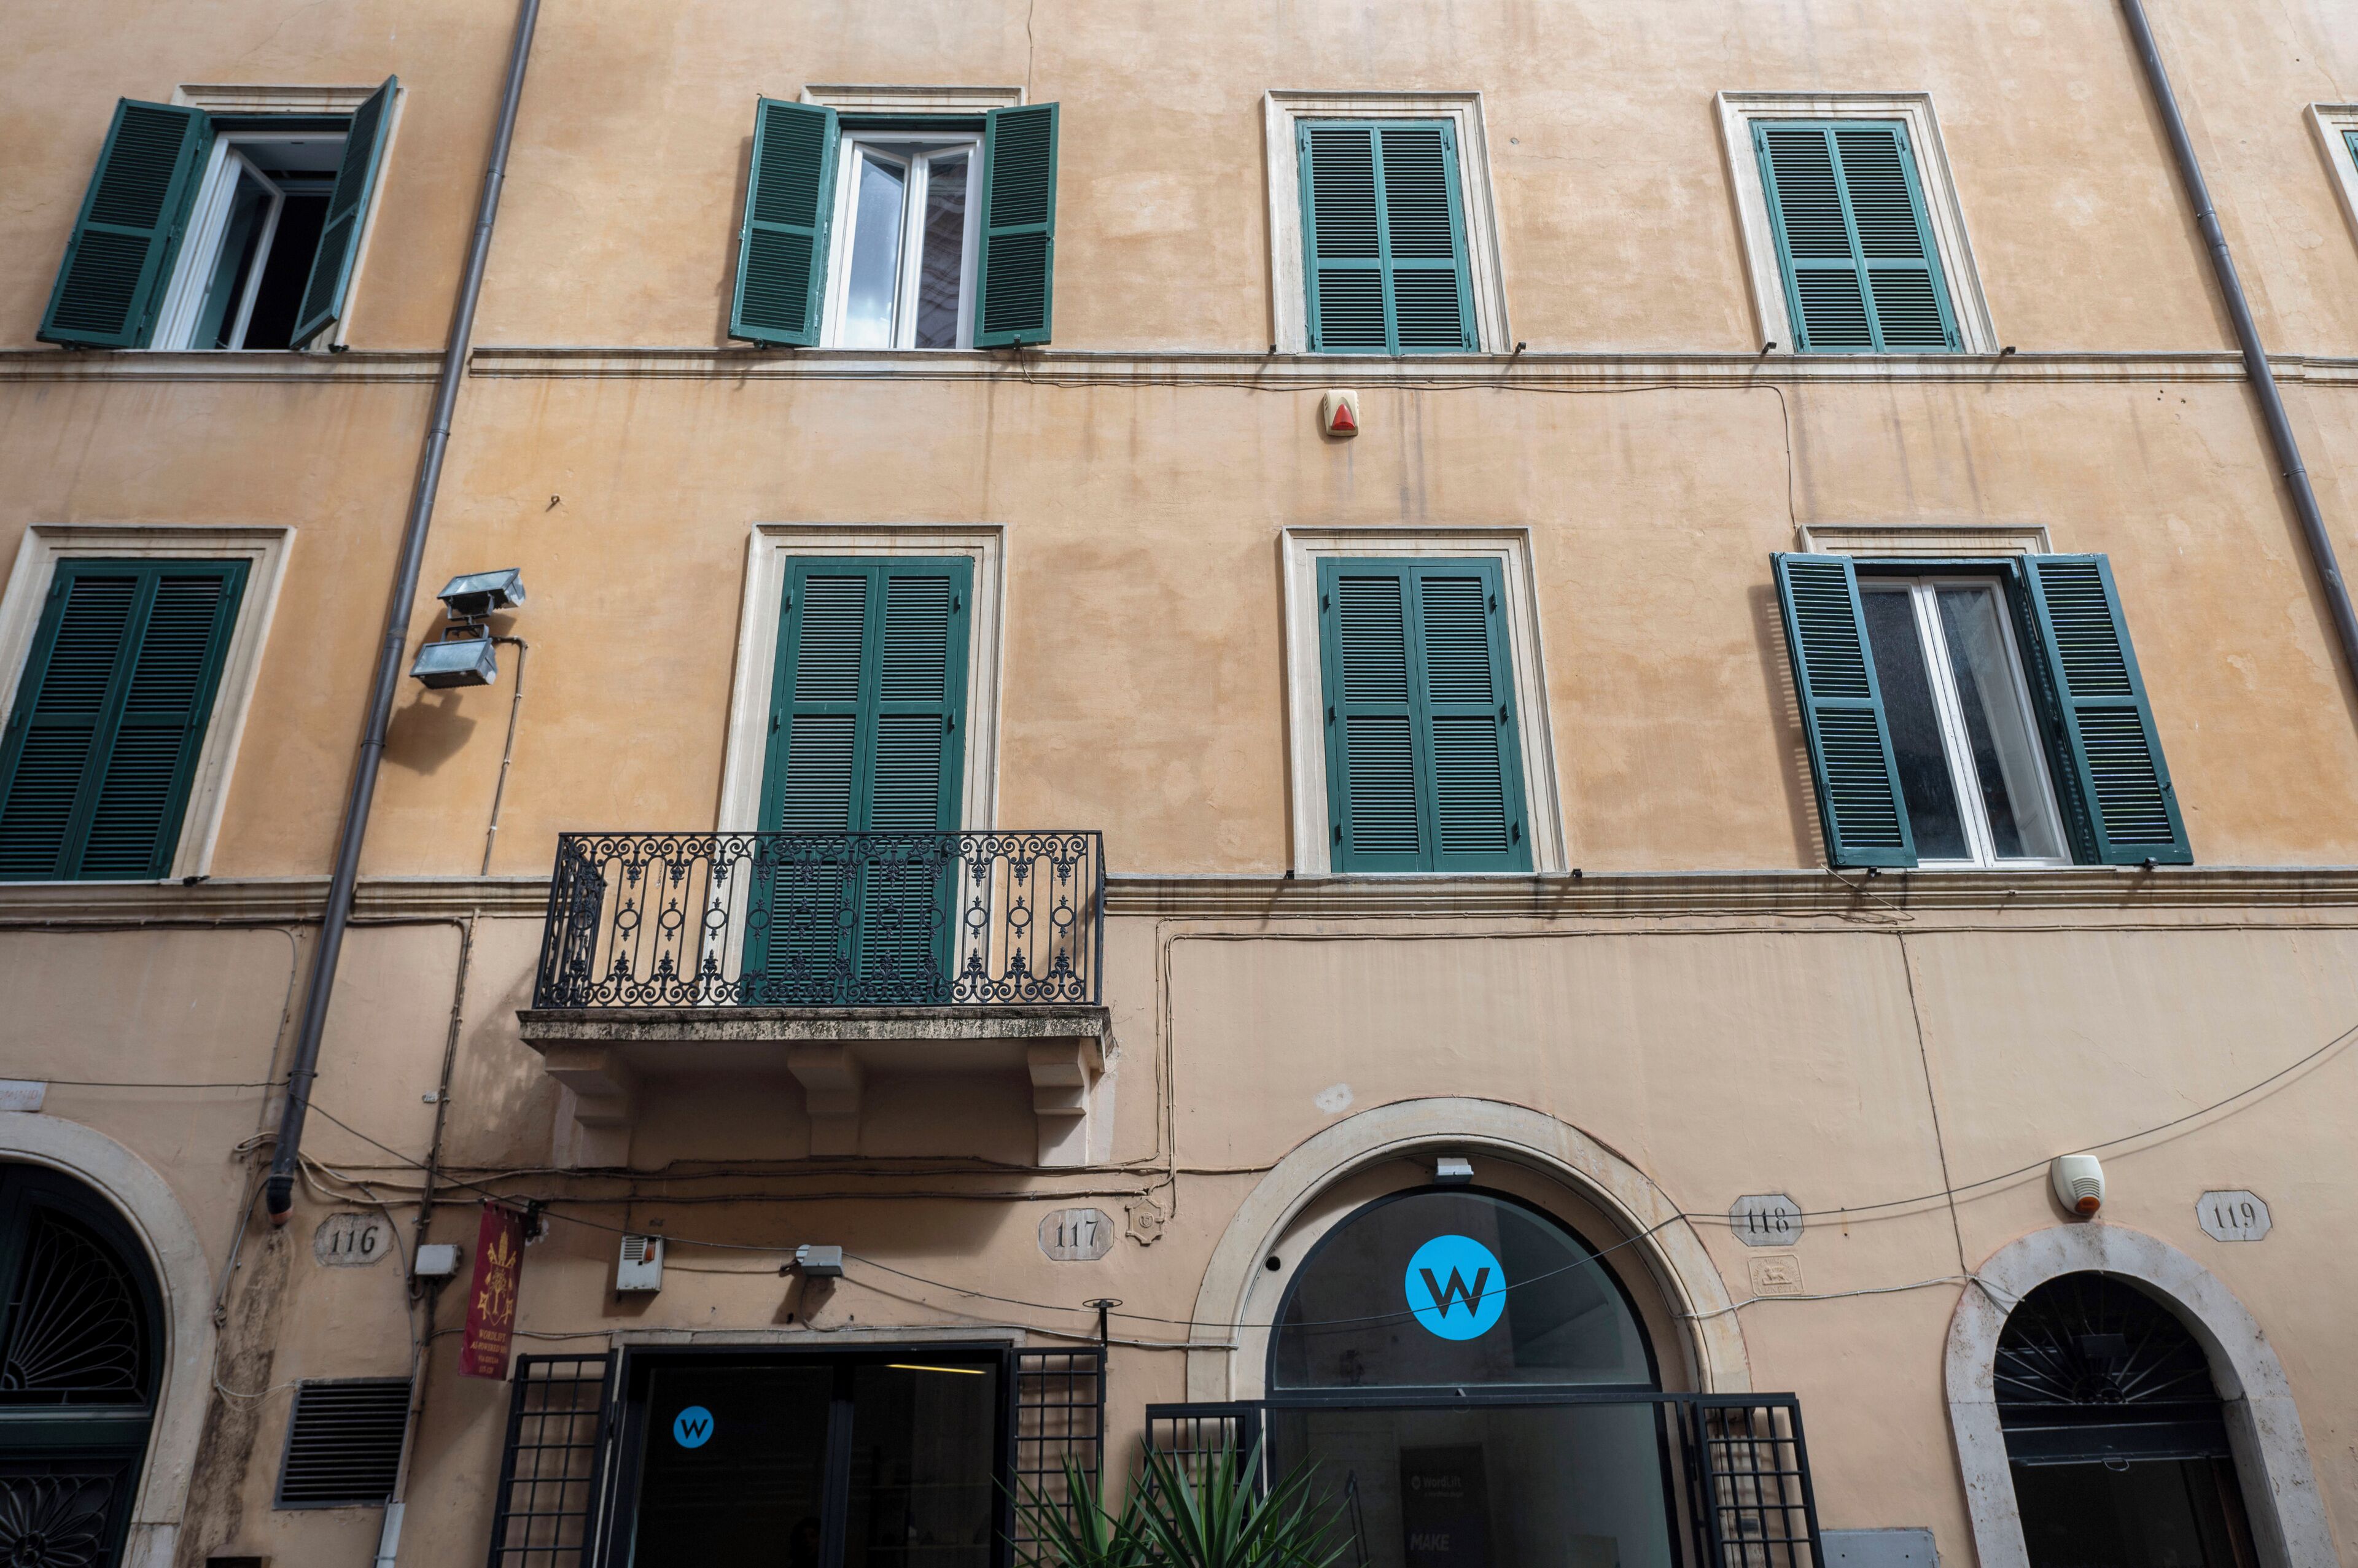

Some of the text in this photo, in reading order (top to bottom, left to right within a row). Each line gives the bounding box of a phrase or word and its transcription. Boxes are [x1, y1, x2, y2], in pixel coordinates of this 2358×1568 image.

[1747, 1206, 1790, 1234] 118
[2213, 1202, 2256, 1228] 119
[330, 1225, 378, 1255] 116
[1054, 1219, 1099, 1248] 117
[1418, 1265, 1490, 1319] W
[478, 1329, 507, 1343] WORDLIFT
[680, 1418, 709, 1440] W
[1423, 1475, 1461, 1488] WordLift
[1411, 1533, 1450, 1551] MAKE
